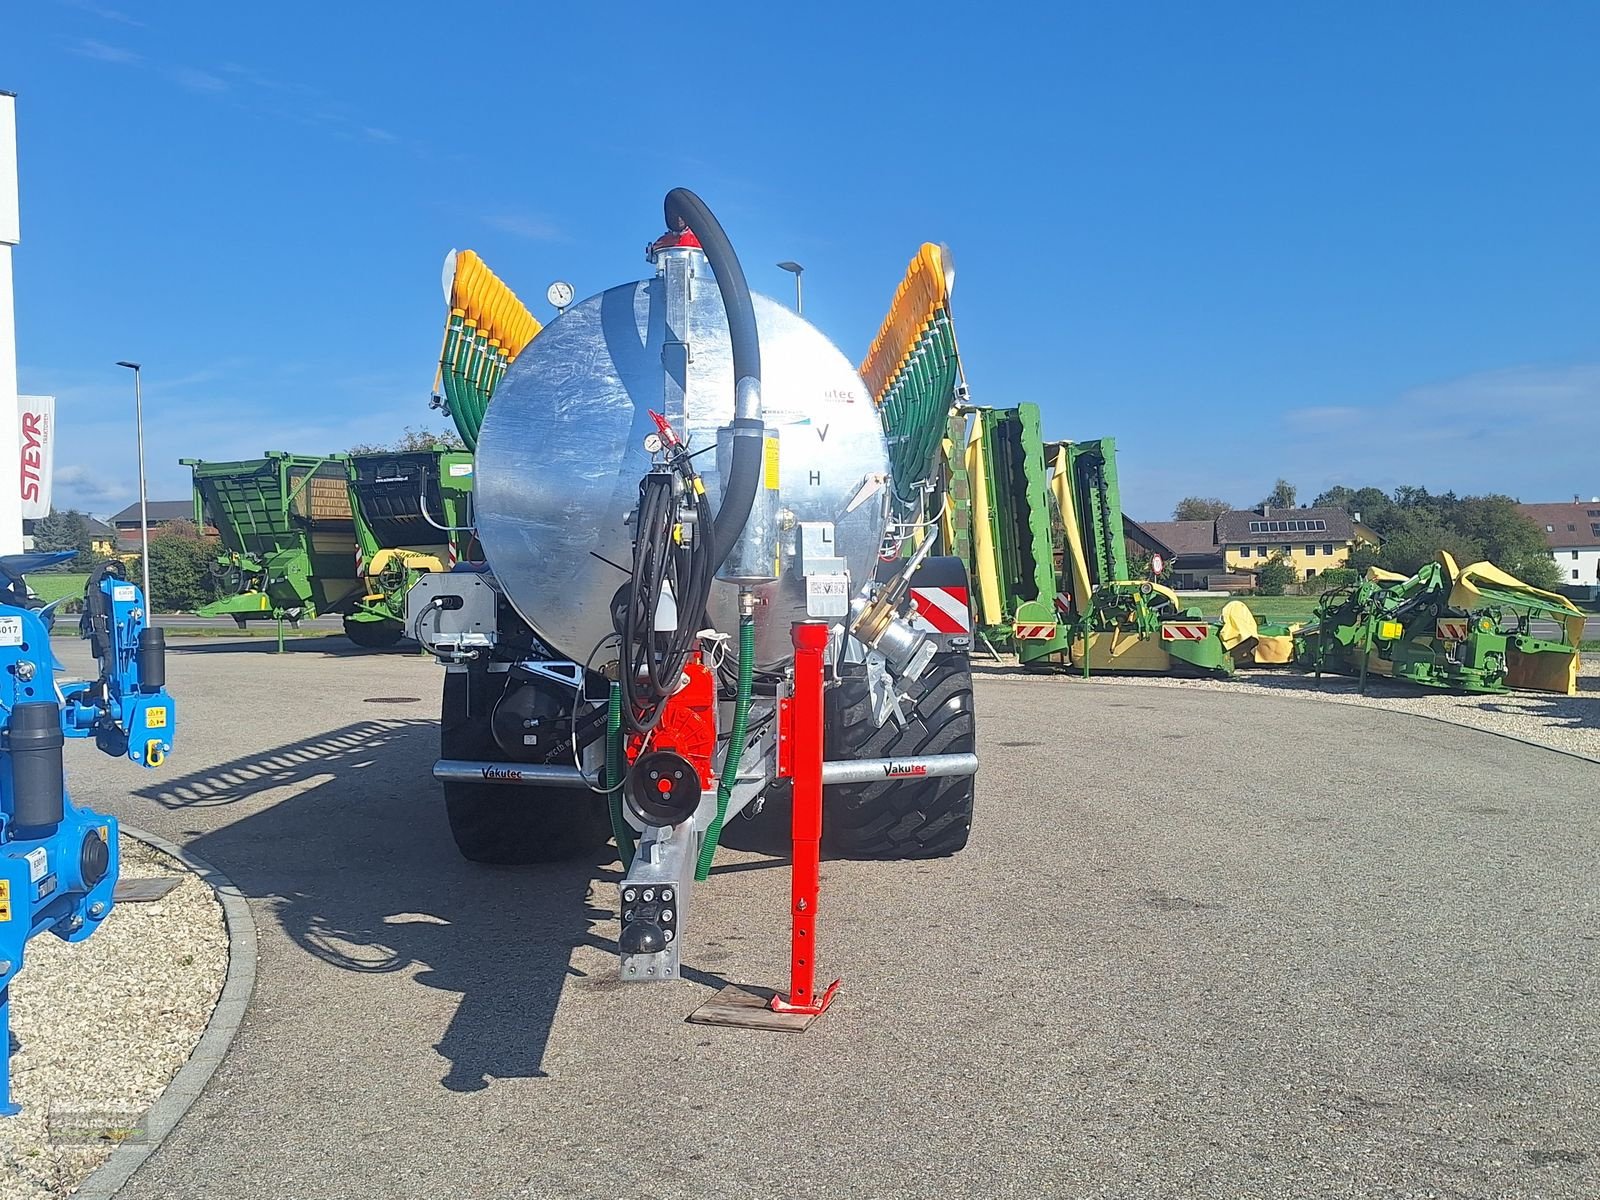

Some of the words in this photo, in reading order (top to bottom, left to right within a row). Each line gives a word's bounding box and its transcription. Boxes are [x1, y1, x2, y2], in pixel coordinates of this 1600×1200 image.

[816, 424, 829, 442] V
[21, 412, 41, 503] STEYR
[809, 470, 820, 486] H
[823, 528, 832, 543] L
[481, 764, 523, 780] Vakutec
[883, 761, 927, 777] Vakutec
